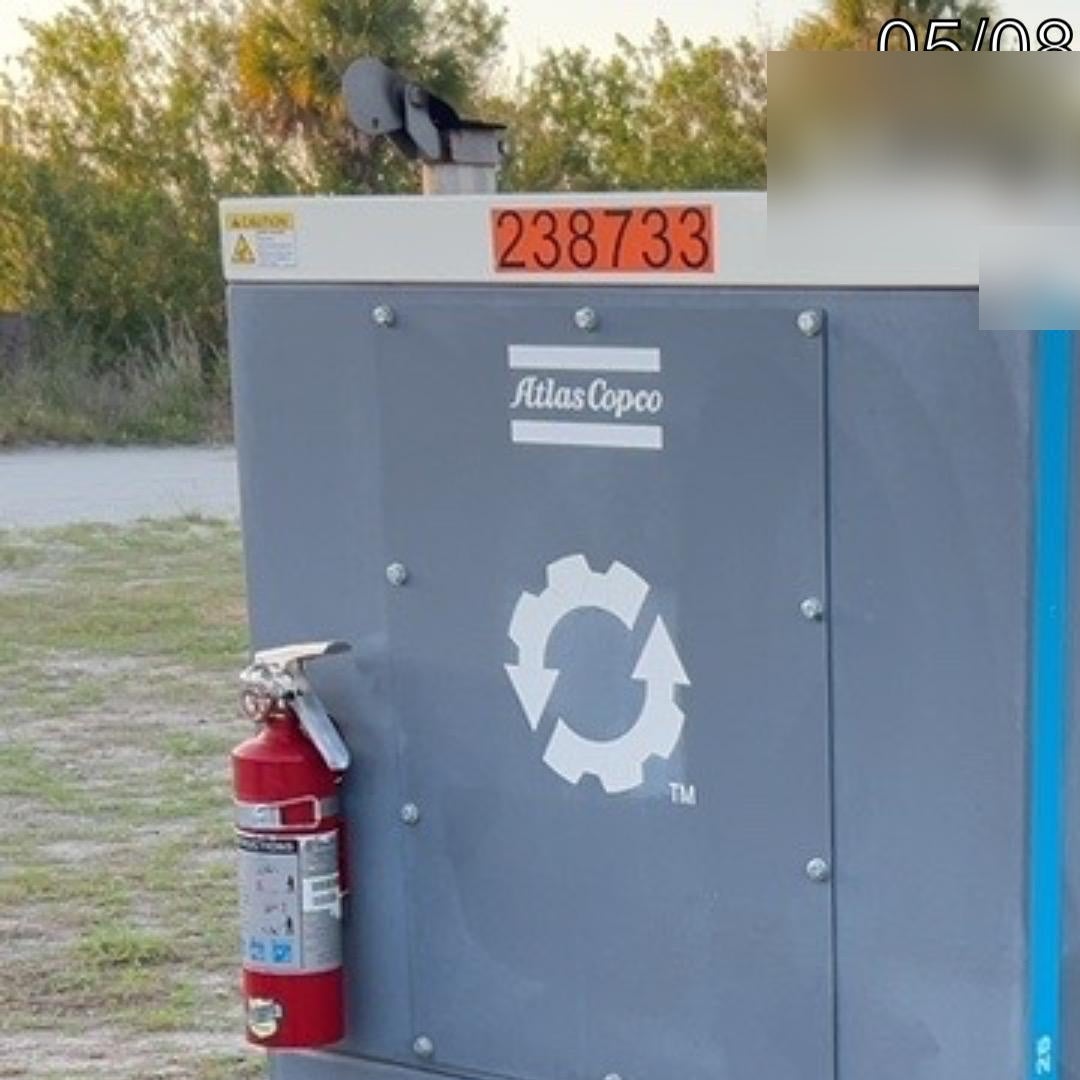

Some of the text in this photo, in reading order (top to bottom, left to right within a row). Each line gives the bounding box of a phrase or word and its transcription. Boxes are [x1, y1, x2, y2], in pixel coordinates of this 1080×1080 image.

[496, 207, 710, 270] 238733
[509, 375, 664, 418] Atlas Copco
[668, 781, 697, 805] TM
